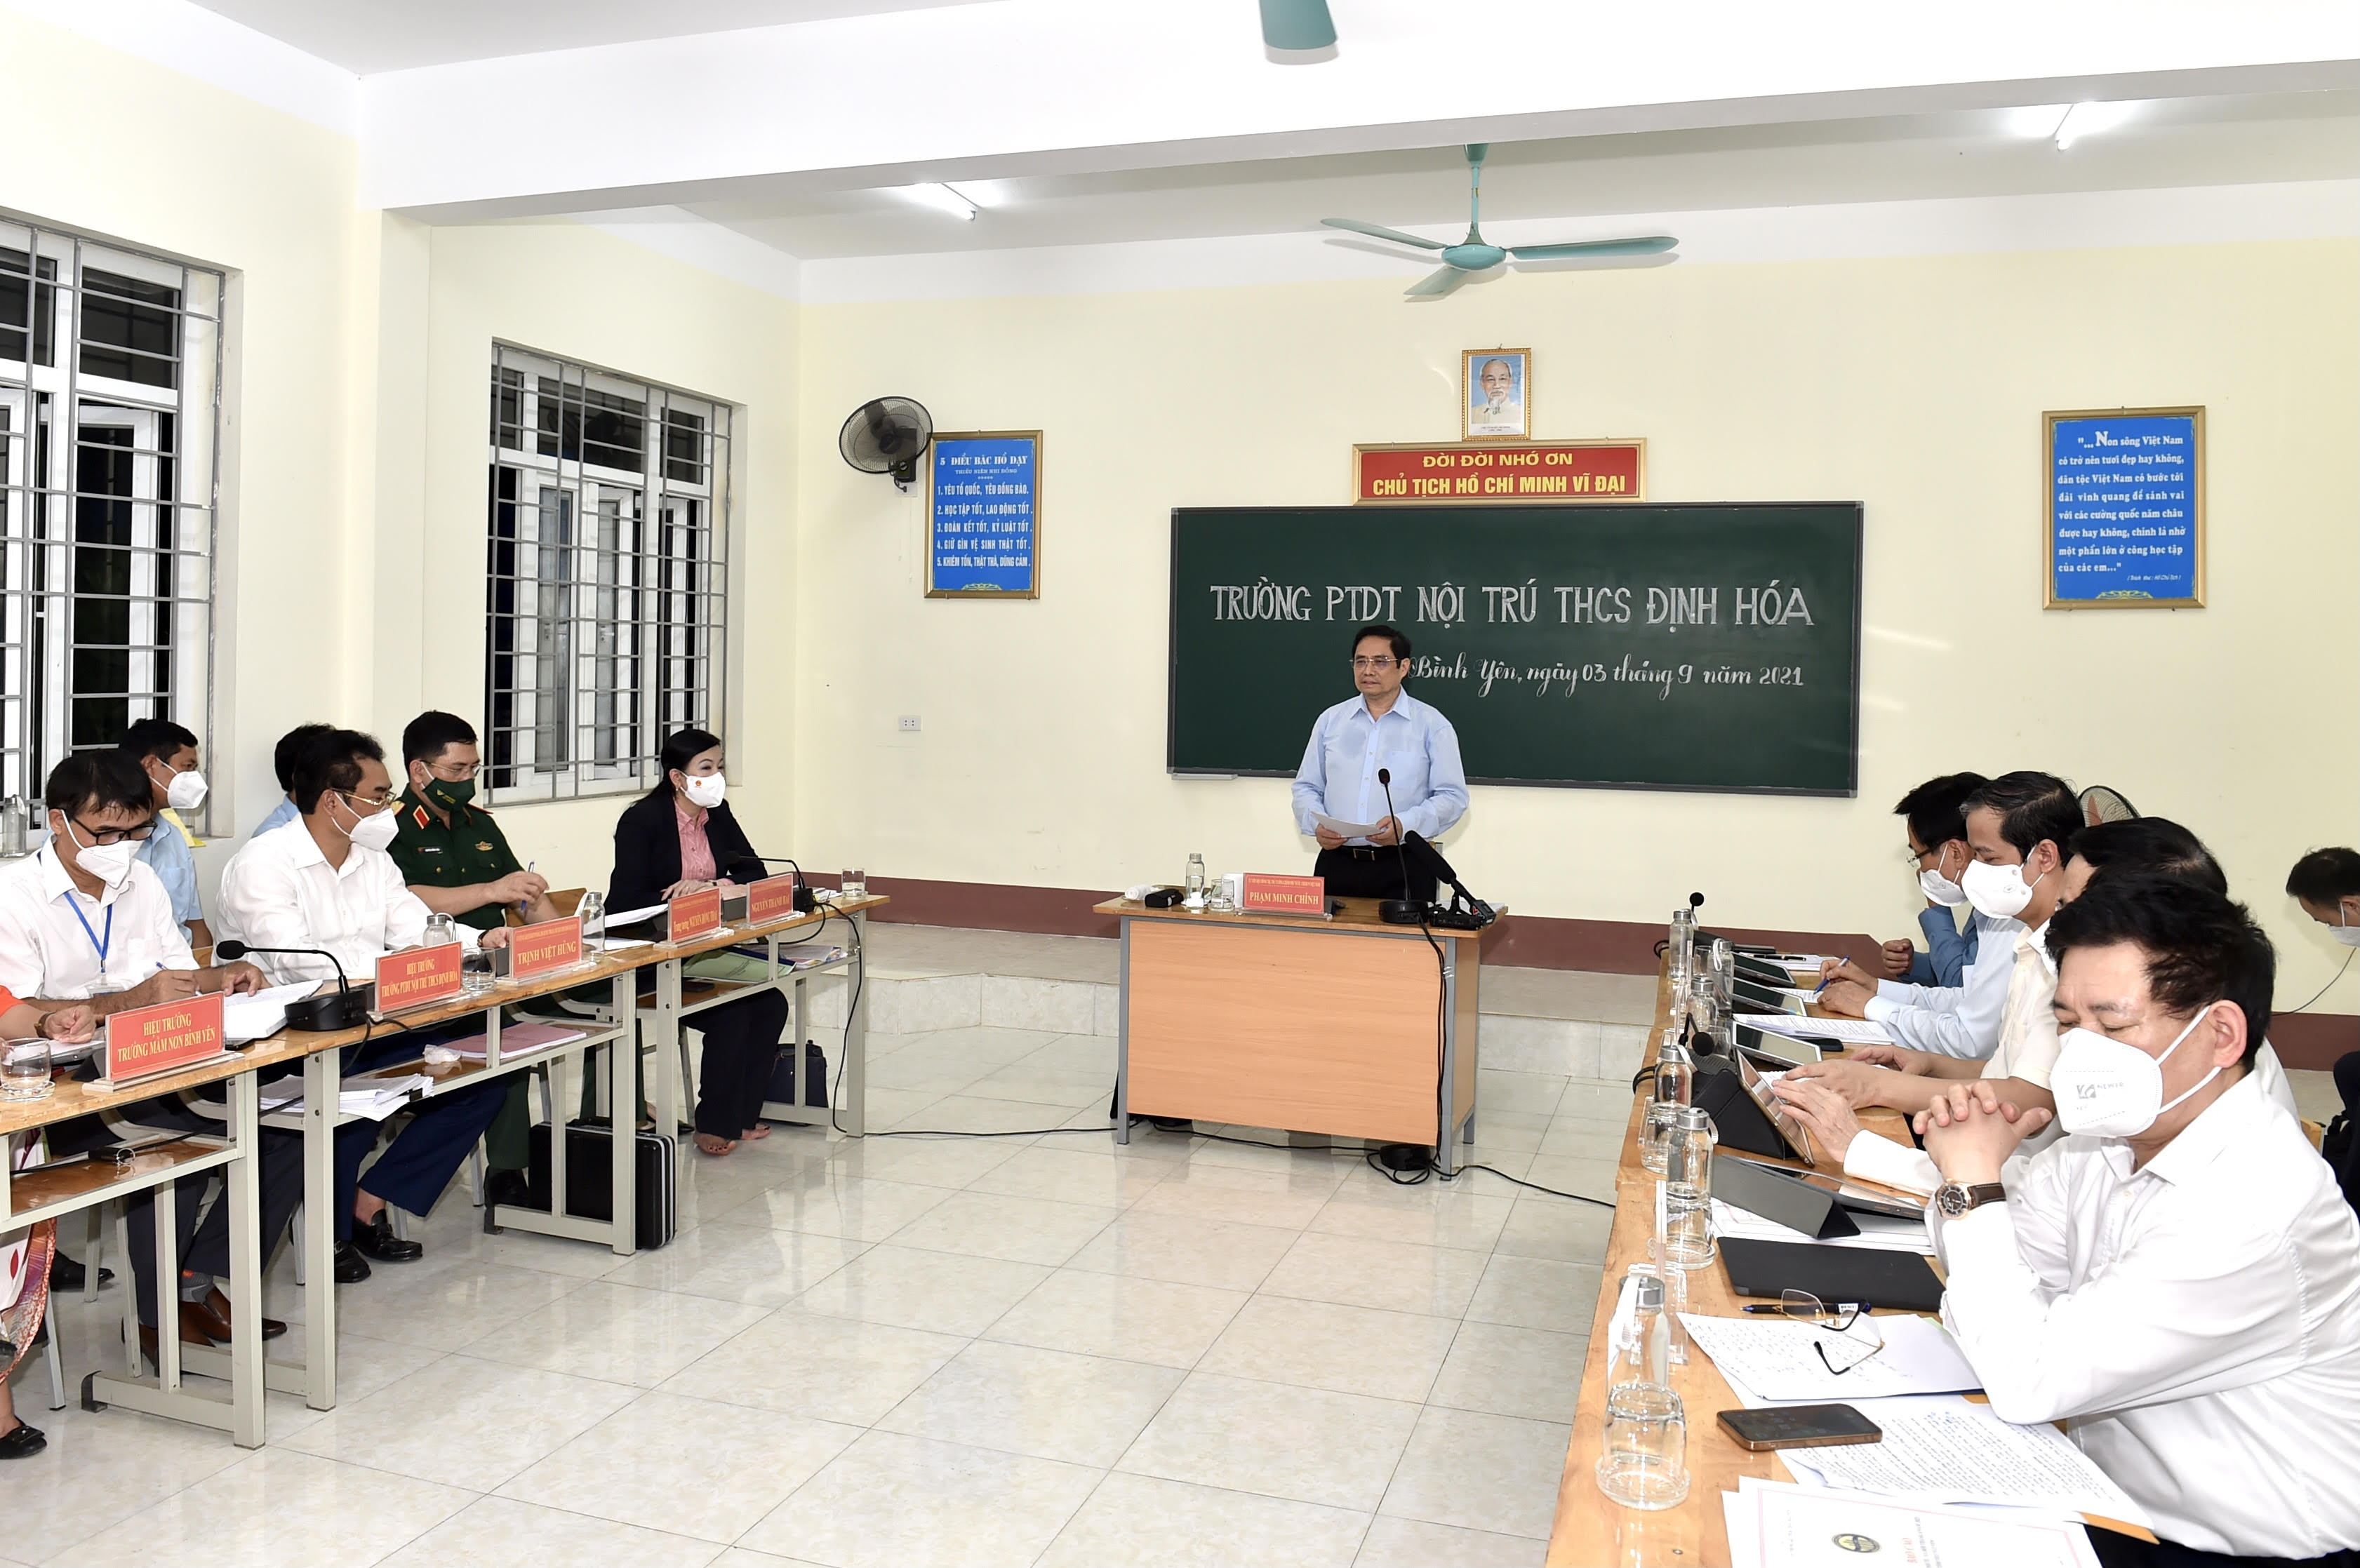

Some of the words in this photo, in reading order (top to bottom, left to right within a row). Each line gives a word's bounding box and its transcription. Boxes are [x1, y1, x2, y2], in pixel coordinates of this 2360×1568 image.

[2120, 437, 2140, 447] sông
[2142, 436, 2161, 447] Việt
[2163, 436, 2183, 444] Nam
[951, 453, 972, 465] ĐIỀU
[974, 455, 992, 464] BÁC
[994, 452, 1007, 464] HỒ
[1011, 456, 1027, 467] DẠY
[1422, 452, 1455, 468] ĐỜI
[1460, 451, 1493, 467] ĐỜI
[1499, 450, 1540, 467] NHỚ
[1545, 453, 1573, 466] ƠN
[2058, 456, 2068, 465] có
[2069, 455, 2084, 465] trở
[2085, 456, 2100, 464] nên
[2102, 455, 2119, 464] tươi
[2121, 454, 2136, 465] đẹp
[2138, 454, 2153, 464] hay
[2155, 453, 2184, 464] không,
[1373, 472, 1407, 495] CHỦ
[1413, 478, 1451, 497] TỊCH
[1455, 471, 1479, 494] HỒ
[1484, 474, 1514, 492] CHÍ
[1520, 477, 1567, 492] MINH
[1573, 472, 1590, 492] VĨ
[1595, 475, 1626, 495] ĐẠI
[2058, 475, 2074, 484] dân
[2076, 474, 2090, 485] tộc
[2092, 474, 2111, 485] Việt
[2113, 474, 2133, 483] Nam
[2135, 474, 2145, 482] có
[2147, 472, 2168, 482] bước
[2171, 471, 2184, 481] tới
[938, 485, 943, 495] 1.
[945, 484, 955, 495] YÊU
[965, 482, 982, 495] QUỐC,
[985, 483, 996, 494] YÊU
[2058, 492, 2073, 502] đài
[2078, 492, 2099, 502] vinh
[2101, 492, 2131, 502] quang
[2132, 489, 2142, 500] để
[2145, 490, 2168, 500] sánh
[2170, 490, 2185, 500] vai
[937, 505, 943, 515] 2.
[945, 504, 957, 516] HỌC
[959, 503, 970, 516] TẬP
[972, 502, 985, 516] TỐT,
[986, 504, 997, 514] LAO
[999, 502, 1016, 516] ĐỘNG
[2058, 510, 2073, 520] với
[2074, 511, 2088, 519] các
[2090, 509, 2117, 521] cường
[2119, 508, 2140, 521] quốc
[2141, 509, 2161, 518] năm
[2162, 509, 2183, 518] châu
[937, 523, 943, 532] 3.
[945, 521, 961, 532] ĐOÀN
[964, 519, 975, 532] KẾT
[976, 519, 989, 533] TỐT,
[992, 518, 999, 532] KỶ
[1001, 521, 1016, 534] LUẬT
[2059, 528, 2081, 540] được
[2082, 528, 2098, 539] hay
[2100, 528, 2130, 538] không,
[2132, 527, 2156, 537] chính
[2158, 526, 2166, 536] là
[2168, 526, 2186, 536] nhờ
[937, 540, 942, 549] 4.
[957, 538, 968, 549] GÌN
[971, 538, 978, 551] VỆ
[981, 540, 996, 549] SINH
[999, 537, 1013, 551] THẬT
[2058, 546, 2076, 556] một
[2078, 544, 2100, 556] phần
[2102, 546, 2117, 555] lớn
[2119, 544, 2125, 555] ở
[2127, 546, 2148, 556] công
[2149, 545, 2166, 556] học
[2168, 544, 2183, 556] tập
[937, 557, 942, 566] 5.
[974, 555, 986, 568] THẬT
[2058, 562, 2074, 572] của
[2076, 563, 2091, 572] các
[1210, 576, 1312, 622] TRƯỜNG
[1325, 586, 1402, 622] PTDT
[1416, 582, 1466, 629] NỘI
[1481, 578, 1538, 623] TRÚ
[1554, 587, 1632, 624] THCS
[1646, 587, 1719, 633] ĐỊNH
[1734, 579, 1815, 626] HÓA
[1407, 651, 1469, 679] Bình
[1474, 657, 1523, 698] Yên,
[1526, 662, 1578, 698] ngày
[1582, 663, 1607, 682] 03
[1613, 653, 1674, 700] tháng
[1678, 663, 1693, 684] 9
[1702, 664, 1753, 685] năm
[1759, 666, 1804, 686] 2021
[1250, 892, 1271, 904] PHẠM
[1272, 893, 1293, 904] MINH
[1294, 892, 1319, 904] CHÍNH
[517, 949, 539, 966] TRỊNH
[540, 944, 556, 961] VIỆT
[557, 939, 576, 956] HÙNG
[143, 1018, 160, 1038] HIỆU
[162, 1011, 192, 1032] TRƯỞNG
[118, 1041, 148, 1062] TRƯỜNG
[149, 1037, 167, 1055] MẦM
[168, 1036, 185, 1051] NON
[185, 1028, 201, 1046] BÌNH
[201, 1025, 215, 1043] YÊN
